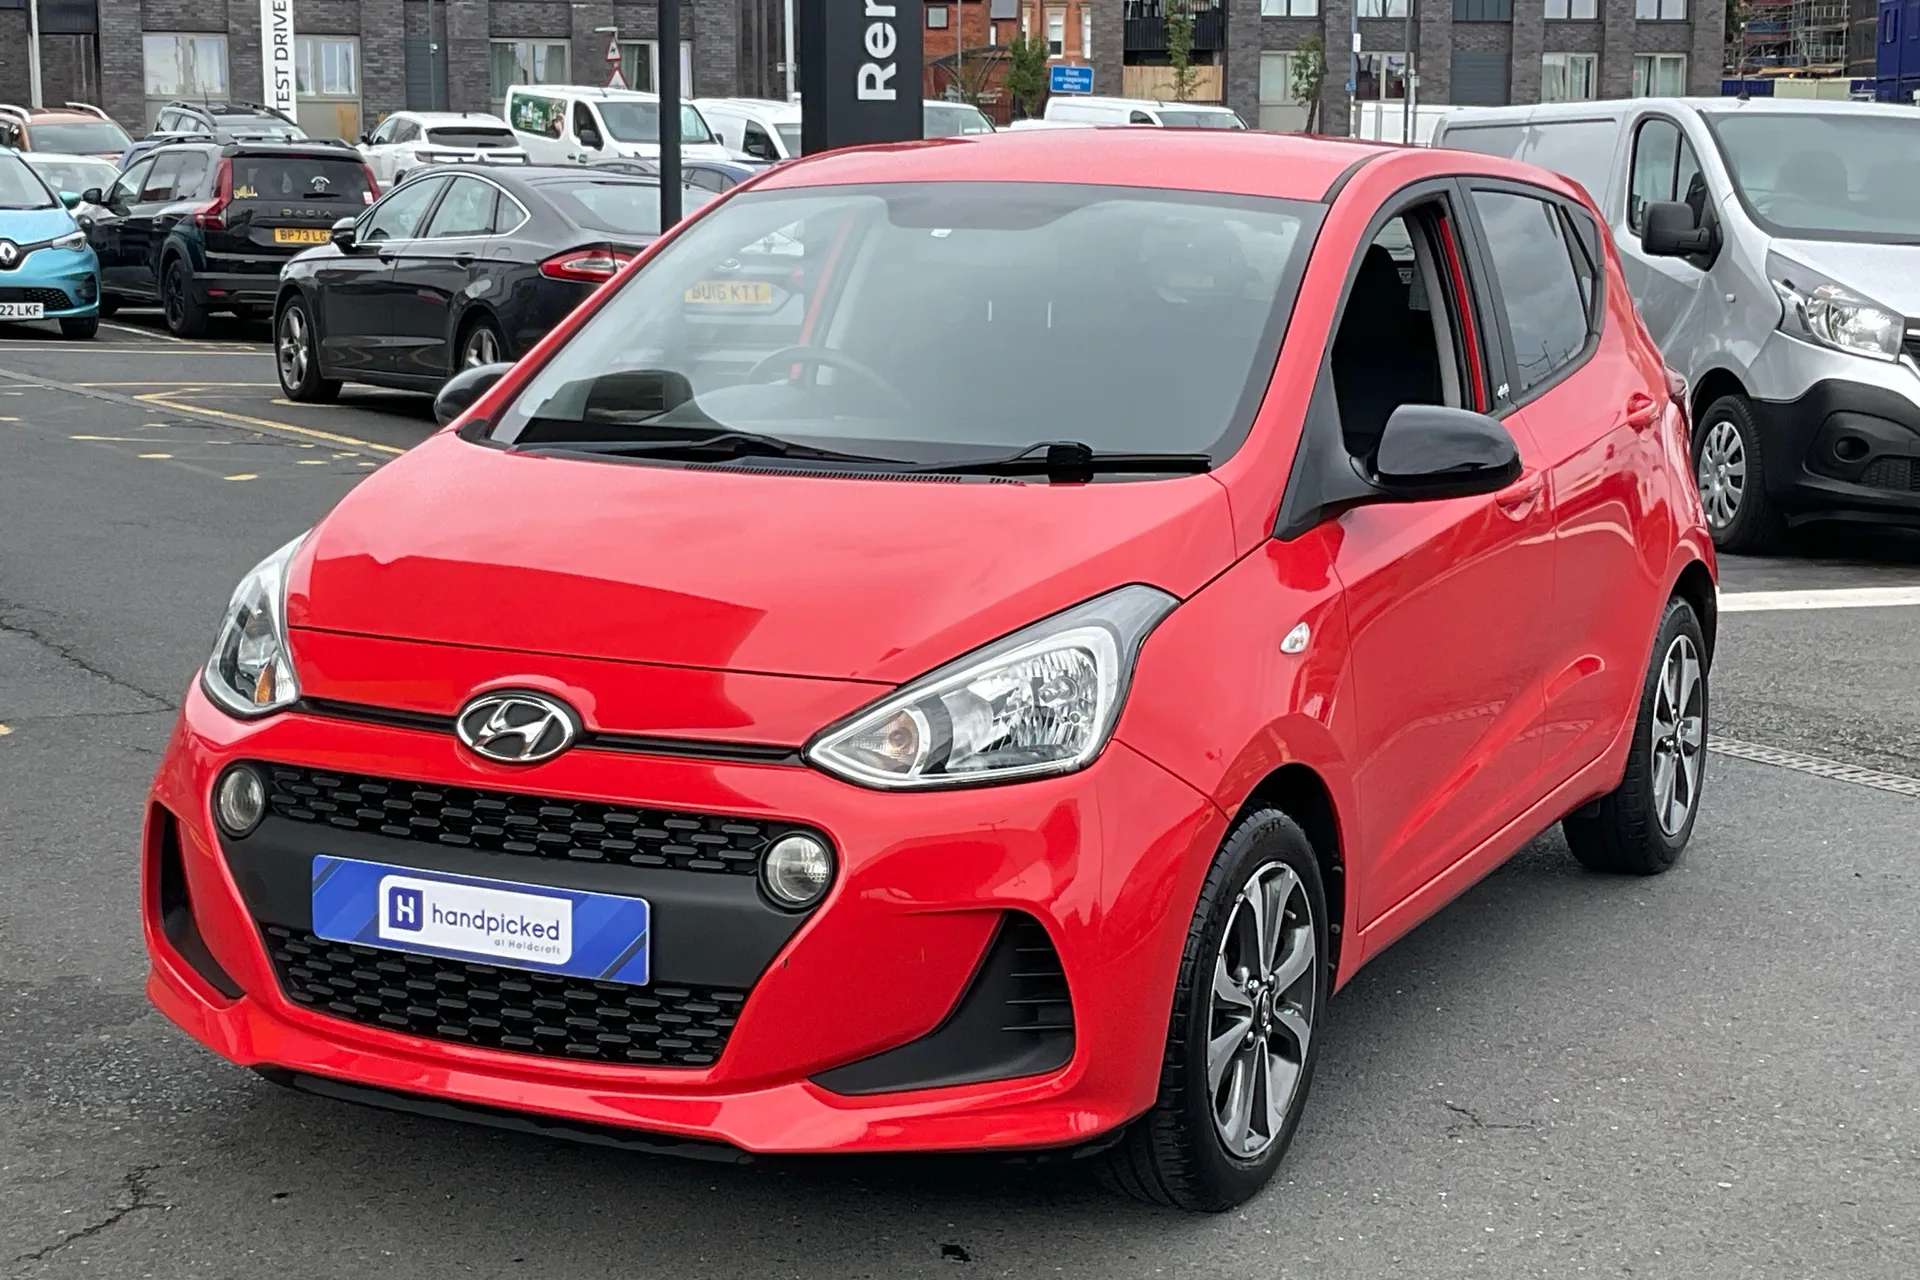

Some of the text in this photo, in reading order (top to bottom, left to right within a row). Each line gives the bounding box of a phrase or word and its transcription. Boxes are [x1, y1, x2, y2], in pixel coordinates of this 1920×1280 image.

[273, 0, 290, 111] TEST DRIVE
[282, 208, 332, 216] DACIA
[280, 229, 309, 241] BP73
[730, 284, 760, 301] KTT
[17, 304, 40, 316] LKF
[432, 903, 560, 941] handpicked
[494, 938, 561, 955] at Holdcroft
